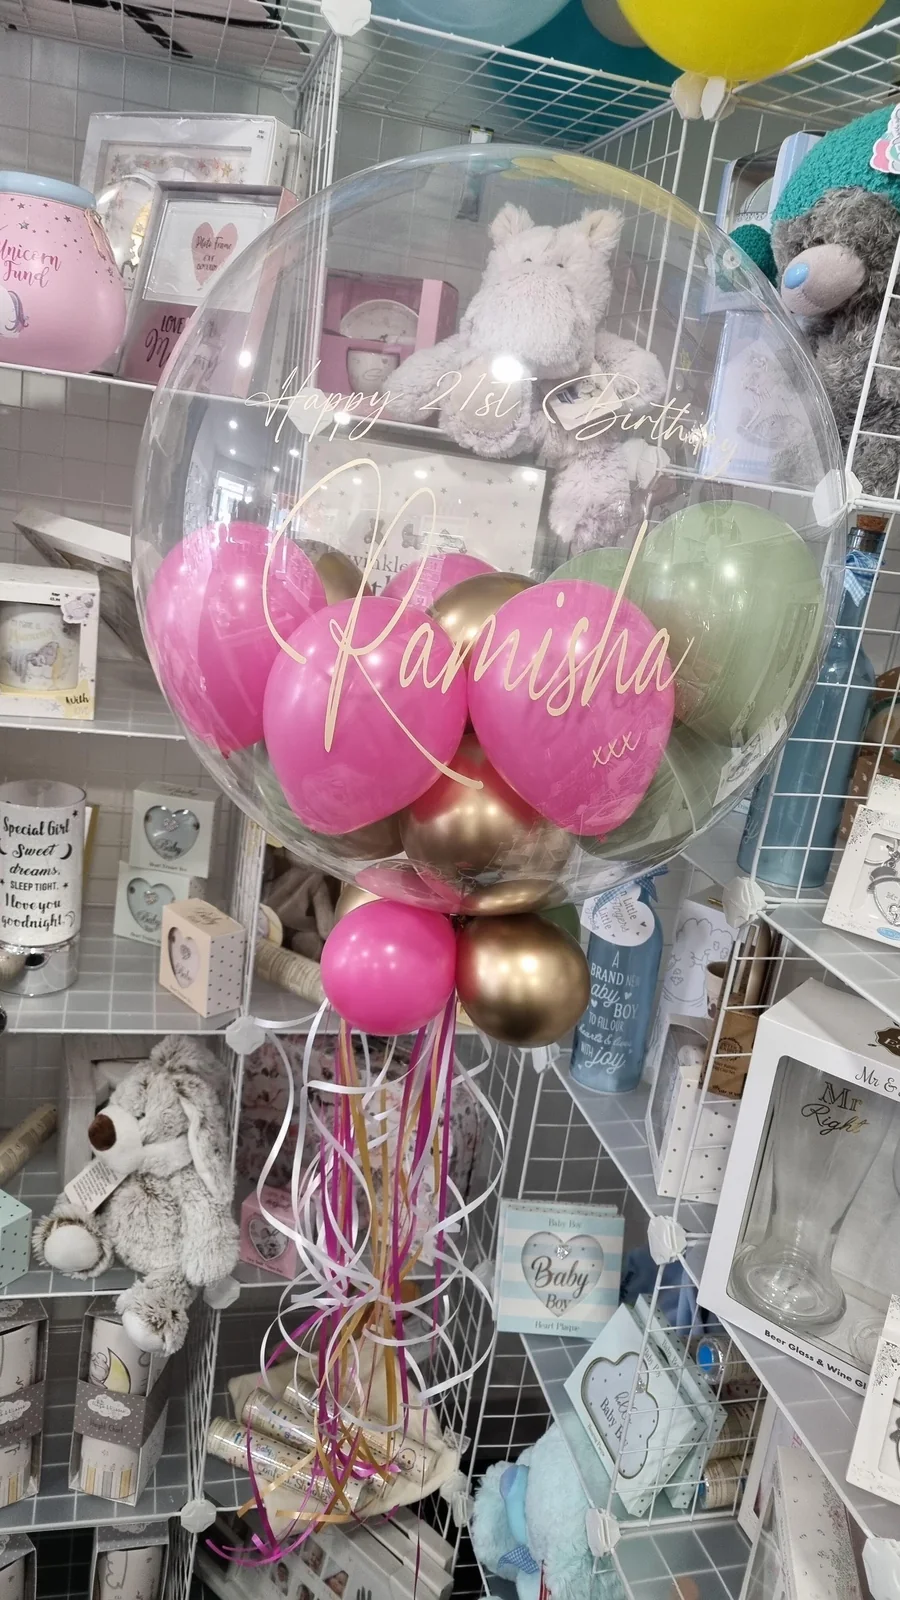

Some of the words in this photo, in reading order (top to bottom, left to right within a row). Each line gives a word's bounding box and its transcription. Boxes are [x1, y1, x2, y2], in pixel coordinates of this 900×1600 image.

[3, 260, 50, 288] Fund
[244, 359, 404, 444] Happy
[418, 370, 538, 418] 21st
[542, 372, 737, 480] Birthy
[347, 551, 409, 574] winkle
[263, 458, 695, 790] Ramisha
[65, 693, 90, 705] With
[3, 816, 45, 837] Special
[47, 818, 70, 836] Girl
[12, 843, 60, 859] Sweet
[9, 863, 61, 876] dreams.
[10, 880, 33, 891] SLEEP
[35, 881, 60, 892] TIGHT.
[11, 894, 37, 910] love
[39, 900, 61, 914] you
[611, 950, 620, 968] A
[590, 963, 624, 986] BRAND
[590, 983, 621, 1008] aby
[613, 1003, 640, 1020] BOY
[610, 1019, 625, 1033] OUR
[580, 1040, 593, 1058] WITH
[585, 1046, 627, 1074] joy
[855, 1065, 880, 1087] Mr
[884, 1077, 897, 1093] &
[818, 1081, 863, 1112] Mr
[801, 1103, 870, 1135] Right
[548, 1218, 566, 1228] Baby
[568, 1220, 582, 1228] Boy
[531, 1255, 590, 1300] Baby
[546, 1293, 573, 1312] Boy
[764, 1329, 786, 1346] Beer
[788, 1343, 814, 1362] Glass
[816, 1358, 825, 1368] &
[827, 1363, 853, 1382] Wine
[600, 1397, 617, 1428] Baby
[614, 1425, 629, 1447] By
